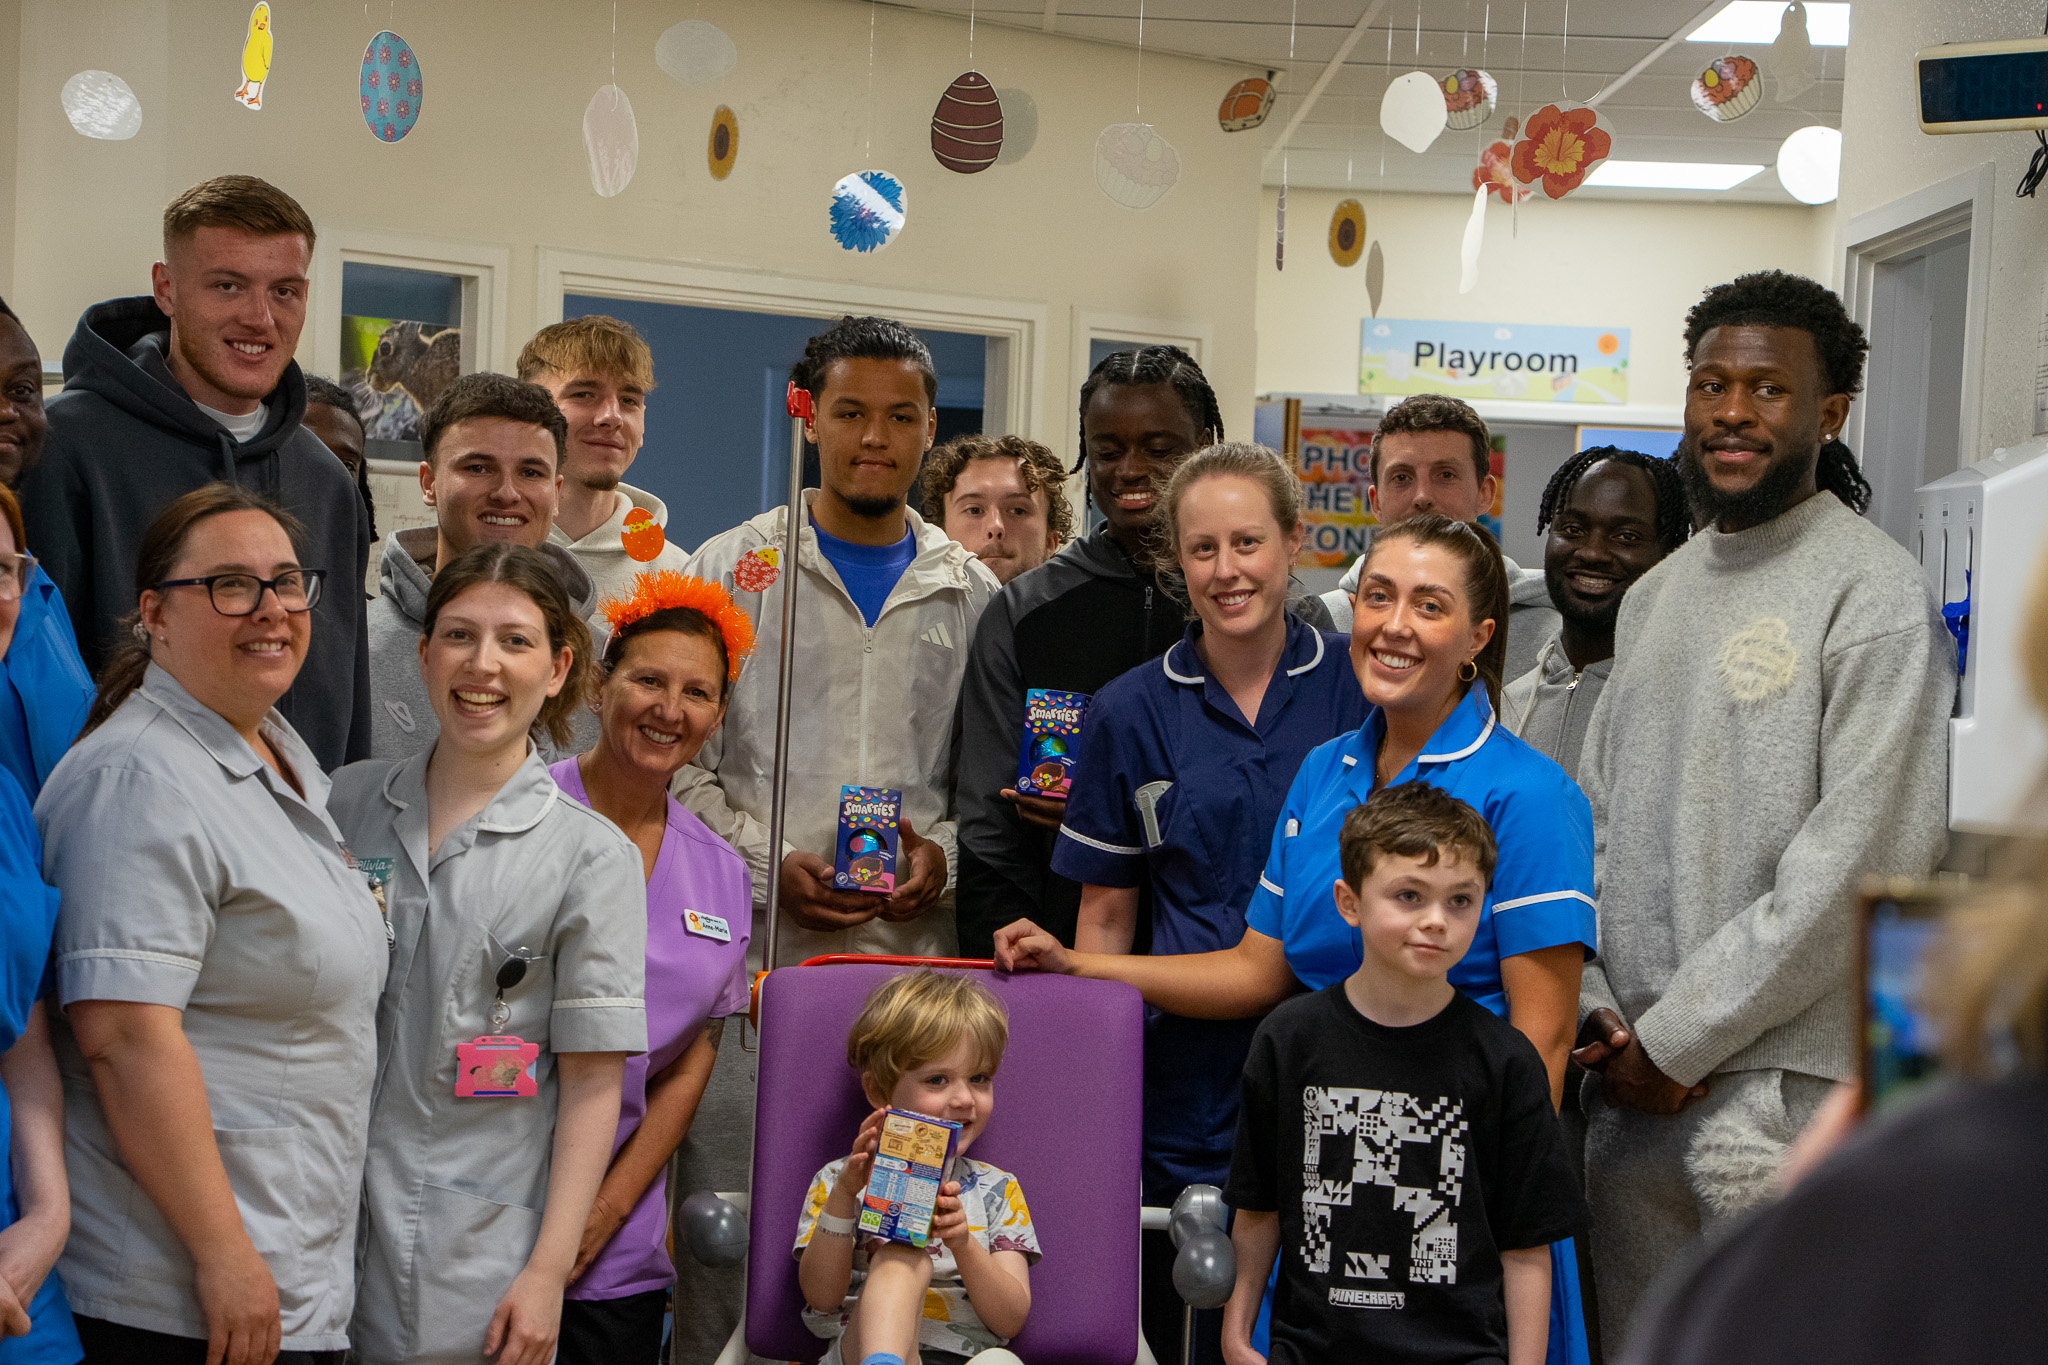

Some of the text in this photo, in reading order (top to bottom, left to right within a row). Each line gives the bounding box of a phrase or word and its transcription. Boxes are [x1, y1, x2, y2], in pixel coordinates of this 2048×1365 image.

[1414, 341, 1578, 377] Playroom
[1304, 1164, 1318, 1173] TNT
[1413, 1258, 1433, 1268] TNT
[1328, 1287, 1405, 1308] MINECRAFT
